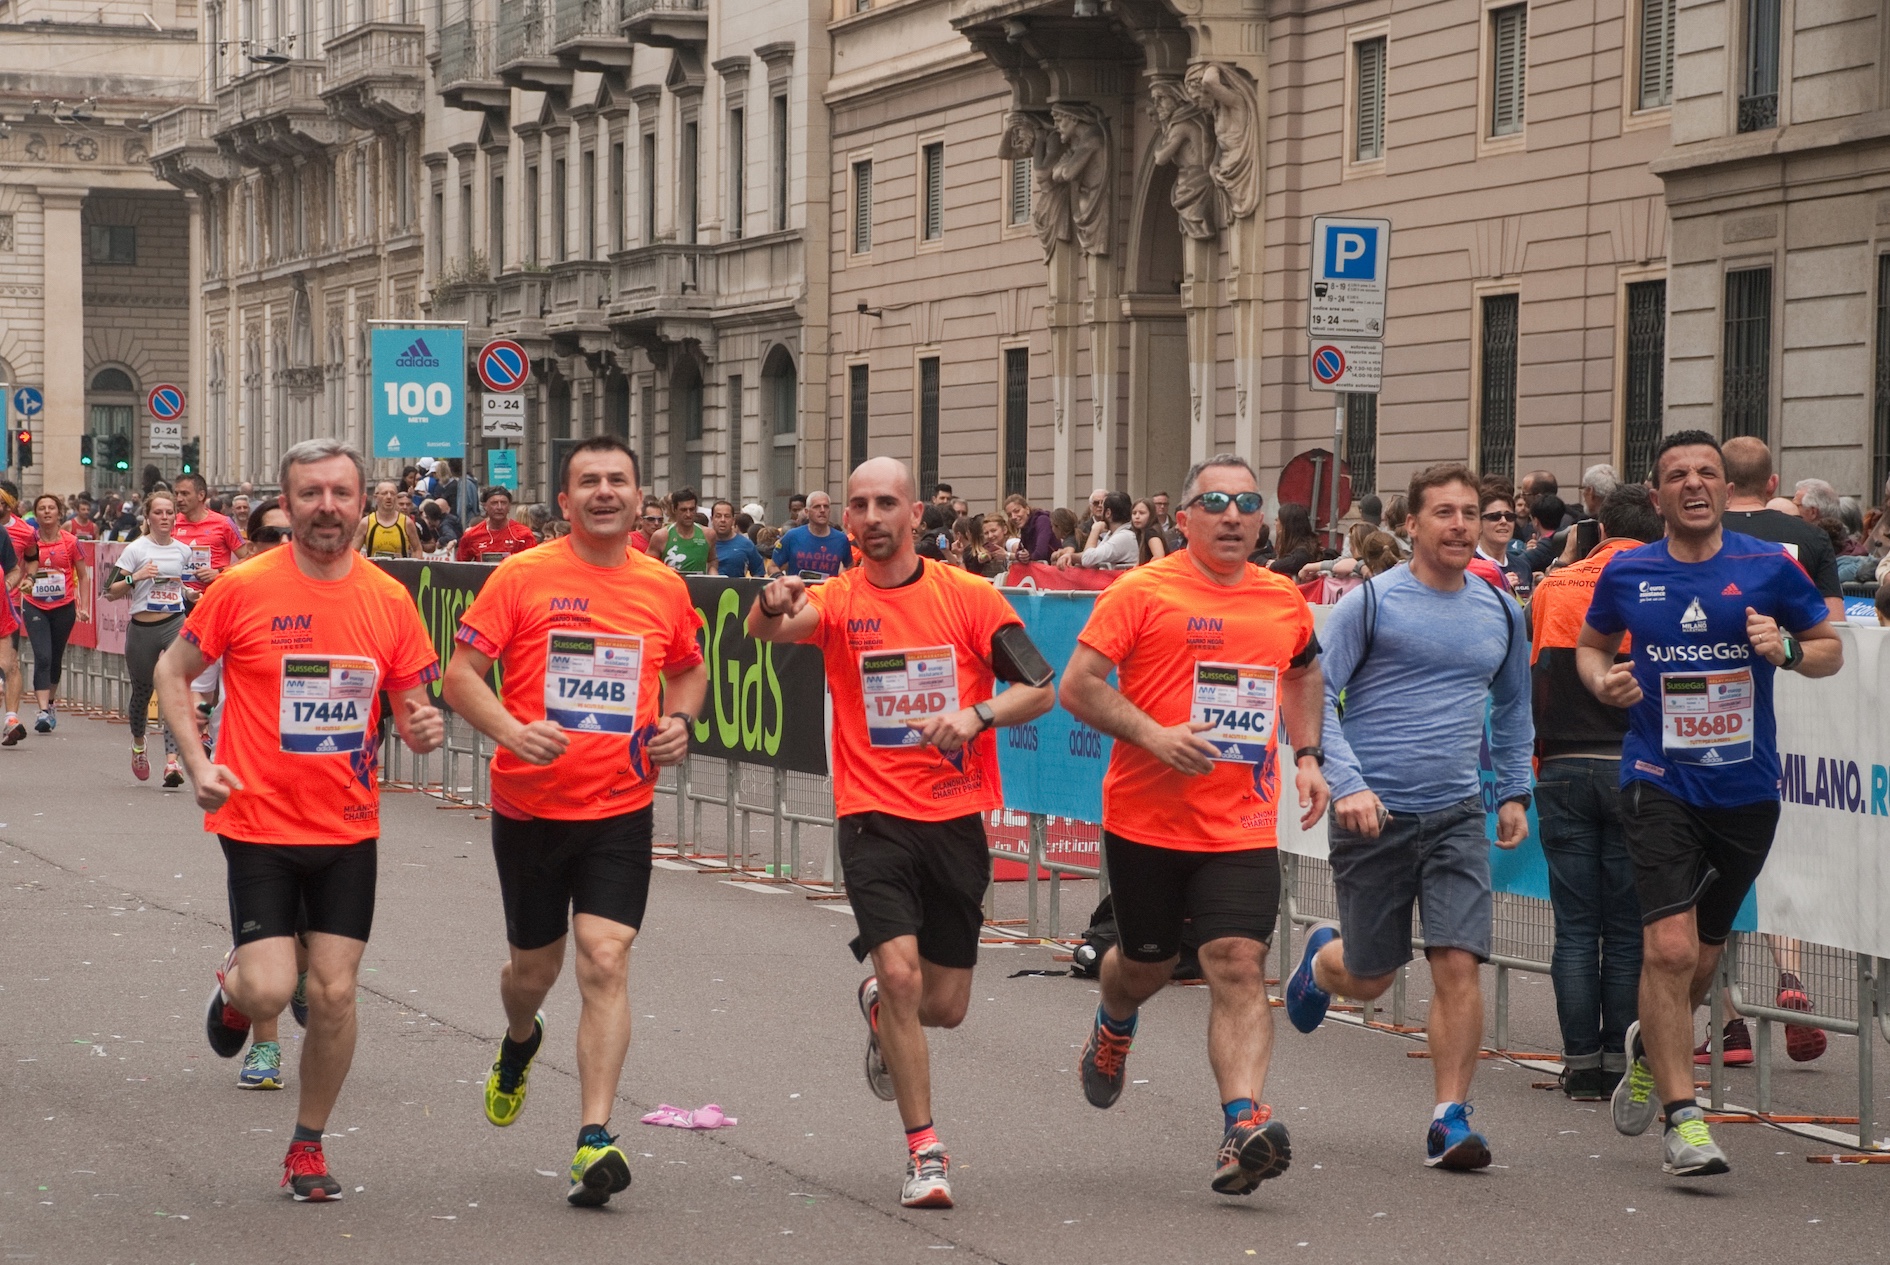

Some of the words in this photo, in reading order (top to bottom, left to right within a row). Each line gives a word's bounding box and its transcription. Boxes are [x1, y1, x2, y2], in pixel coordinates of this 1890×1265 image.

[1334, 232, 1366, 273] P
[1312, 314, 1322, 324] 19
[1328, 315, 1340, 324] 24
[396, 356, 440, 368] adidas
[384, 382, 452, 416] 100
[503, 400, 520, 410] 24
[796, 551, 838, 562] MAGICA
[558, 678, 626, 702] 1744B
[292, 700, 358, 722] 1744A
[874, 692, 946, 716] 1744D
[1204, 708, 1266, 732] 1744C
[1674, 713, 1742, 737] 1368D
[1069, 726, 1102, 760] adidas
[932, 788, 962, 800] CHARITY
[1776, 752, 1866, 814] MILANO.
[1242, 818, 1272, 828] CHARITY
[1018, 838, 1100, 854] Ntrition
